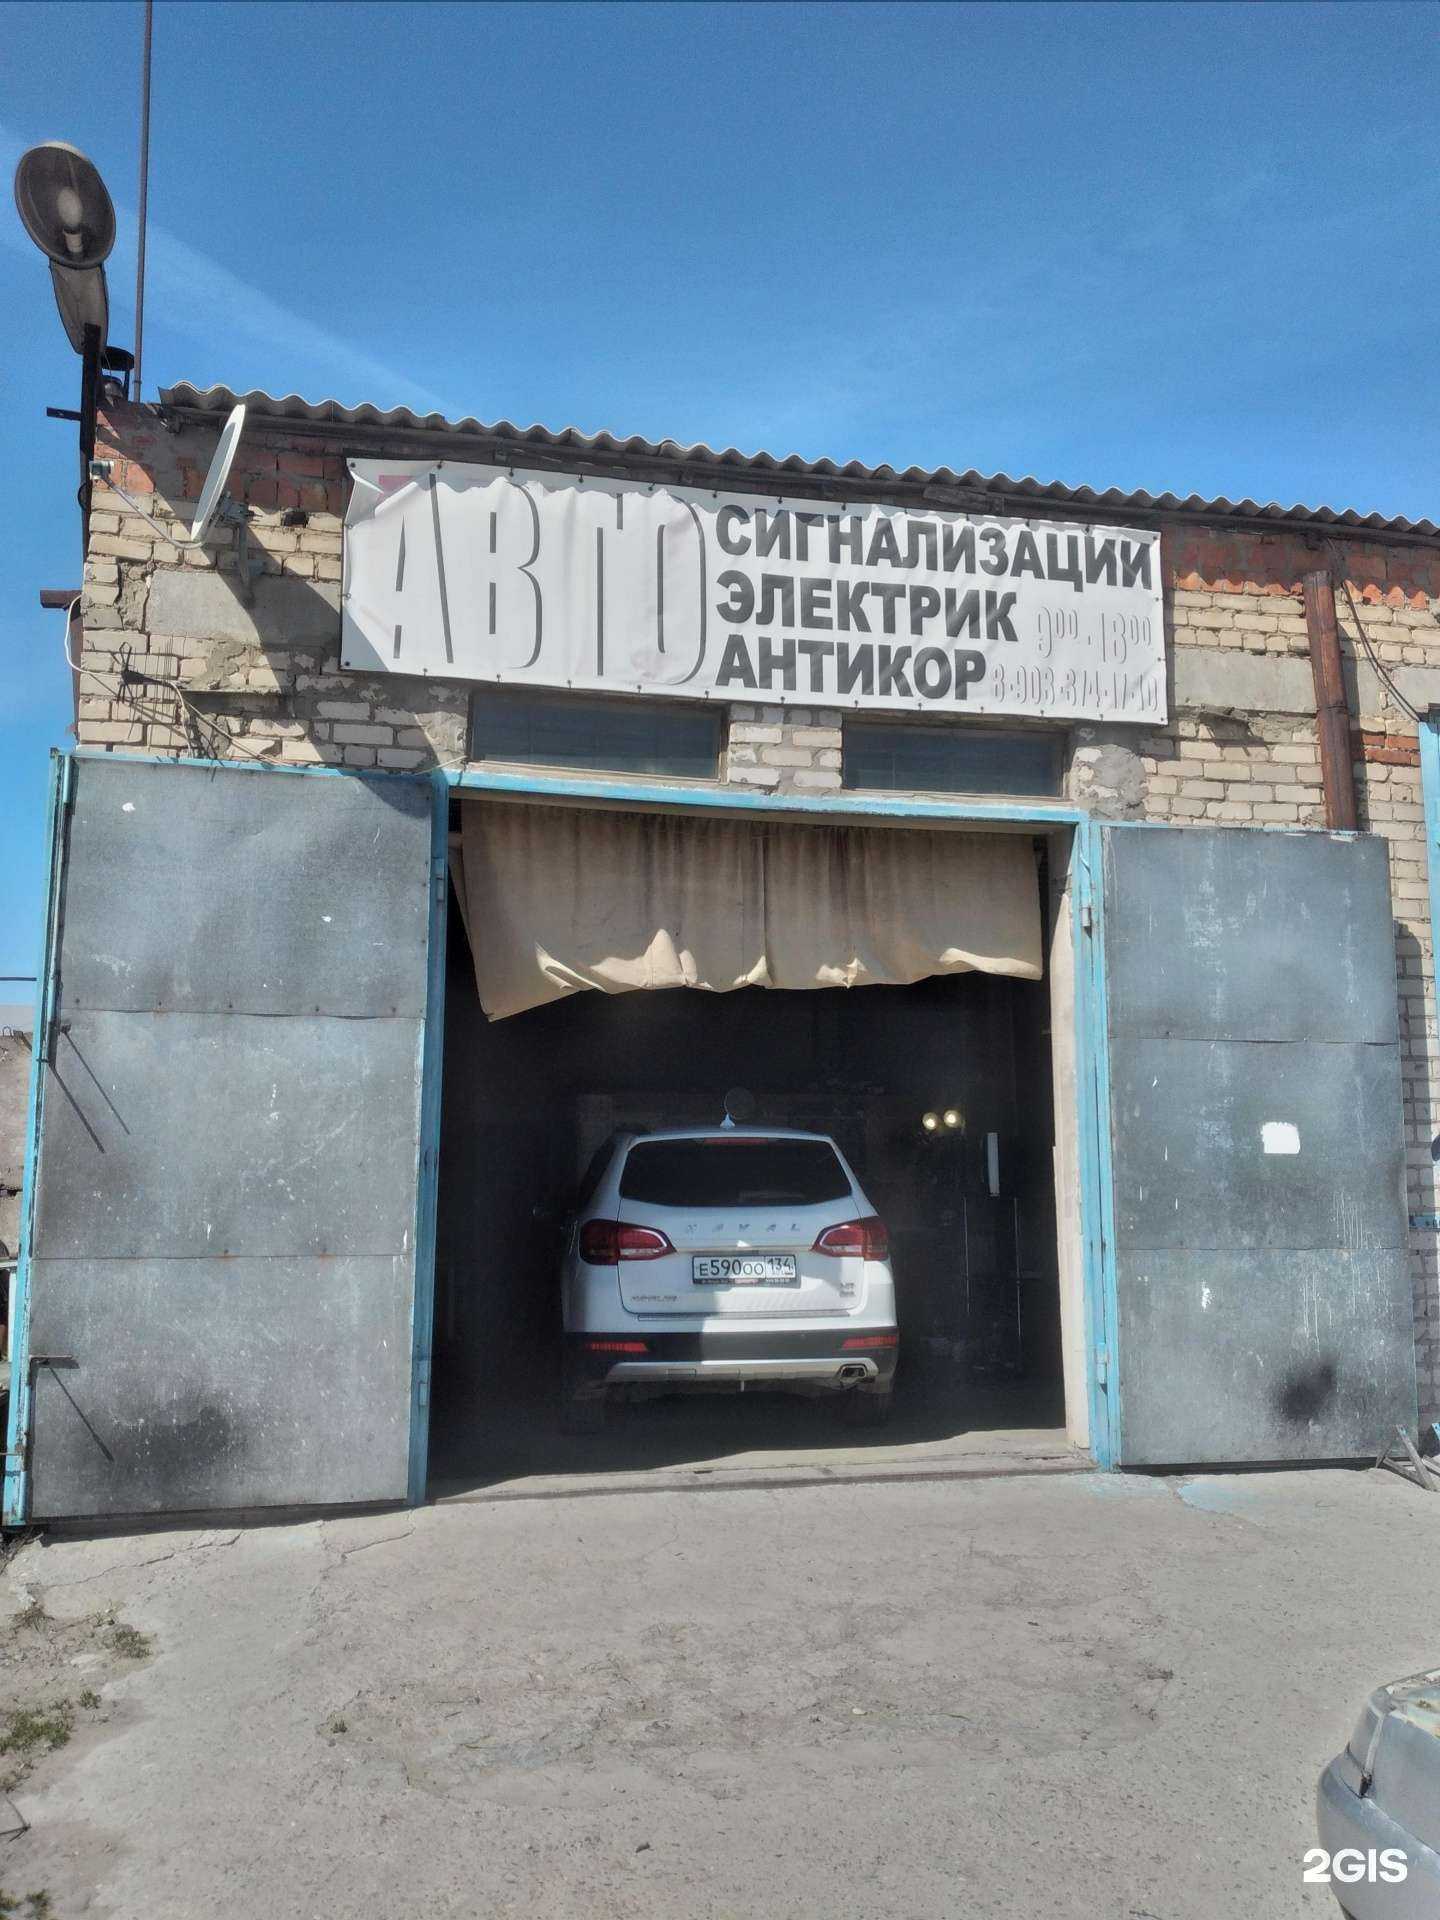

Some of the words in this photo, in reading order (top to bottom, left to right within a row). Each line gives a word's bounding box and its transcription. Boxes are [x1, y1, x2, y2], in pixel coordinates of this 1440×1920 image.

[376, 473, 706, 686] АВТО
[717, 504, 1152, 592] СИГНАЛИЗАЦИИ
[717, 570, 1017, 665] ЭЛЕКТРИК
[716, 633, 987, 701] АНТИКОР
